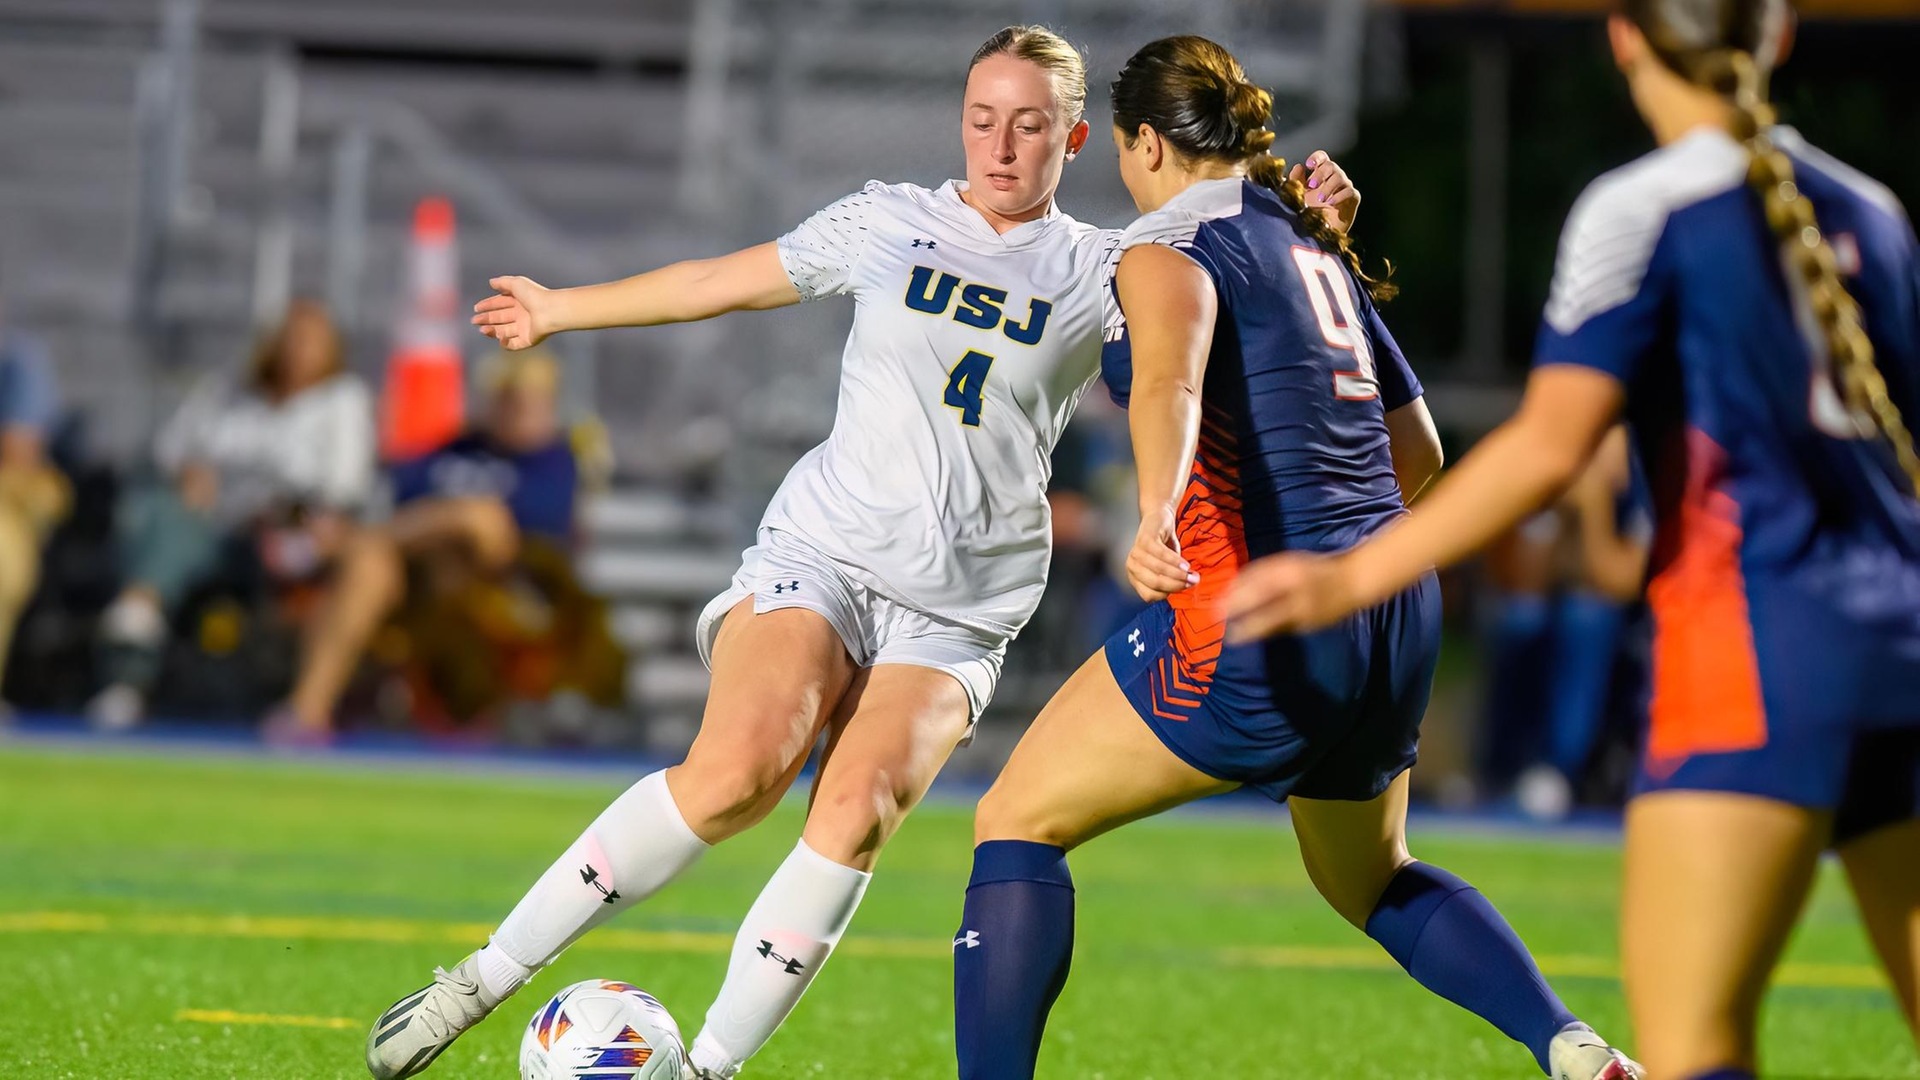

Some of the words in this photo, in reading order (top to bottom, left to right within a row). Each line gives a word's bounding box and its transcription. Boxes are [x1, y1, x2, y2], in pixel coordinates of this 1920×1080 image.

[904, 265, 1053, 346] USJ
[1290, 244, 1380, 401] 9
[942, 348, 996, 428] 4
